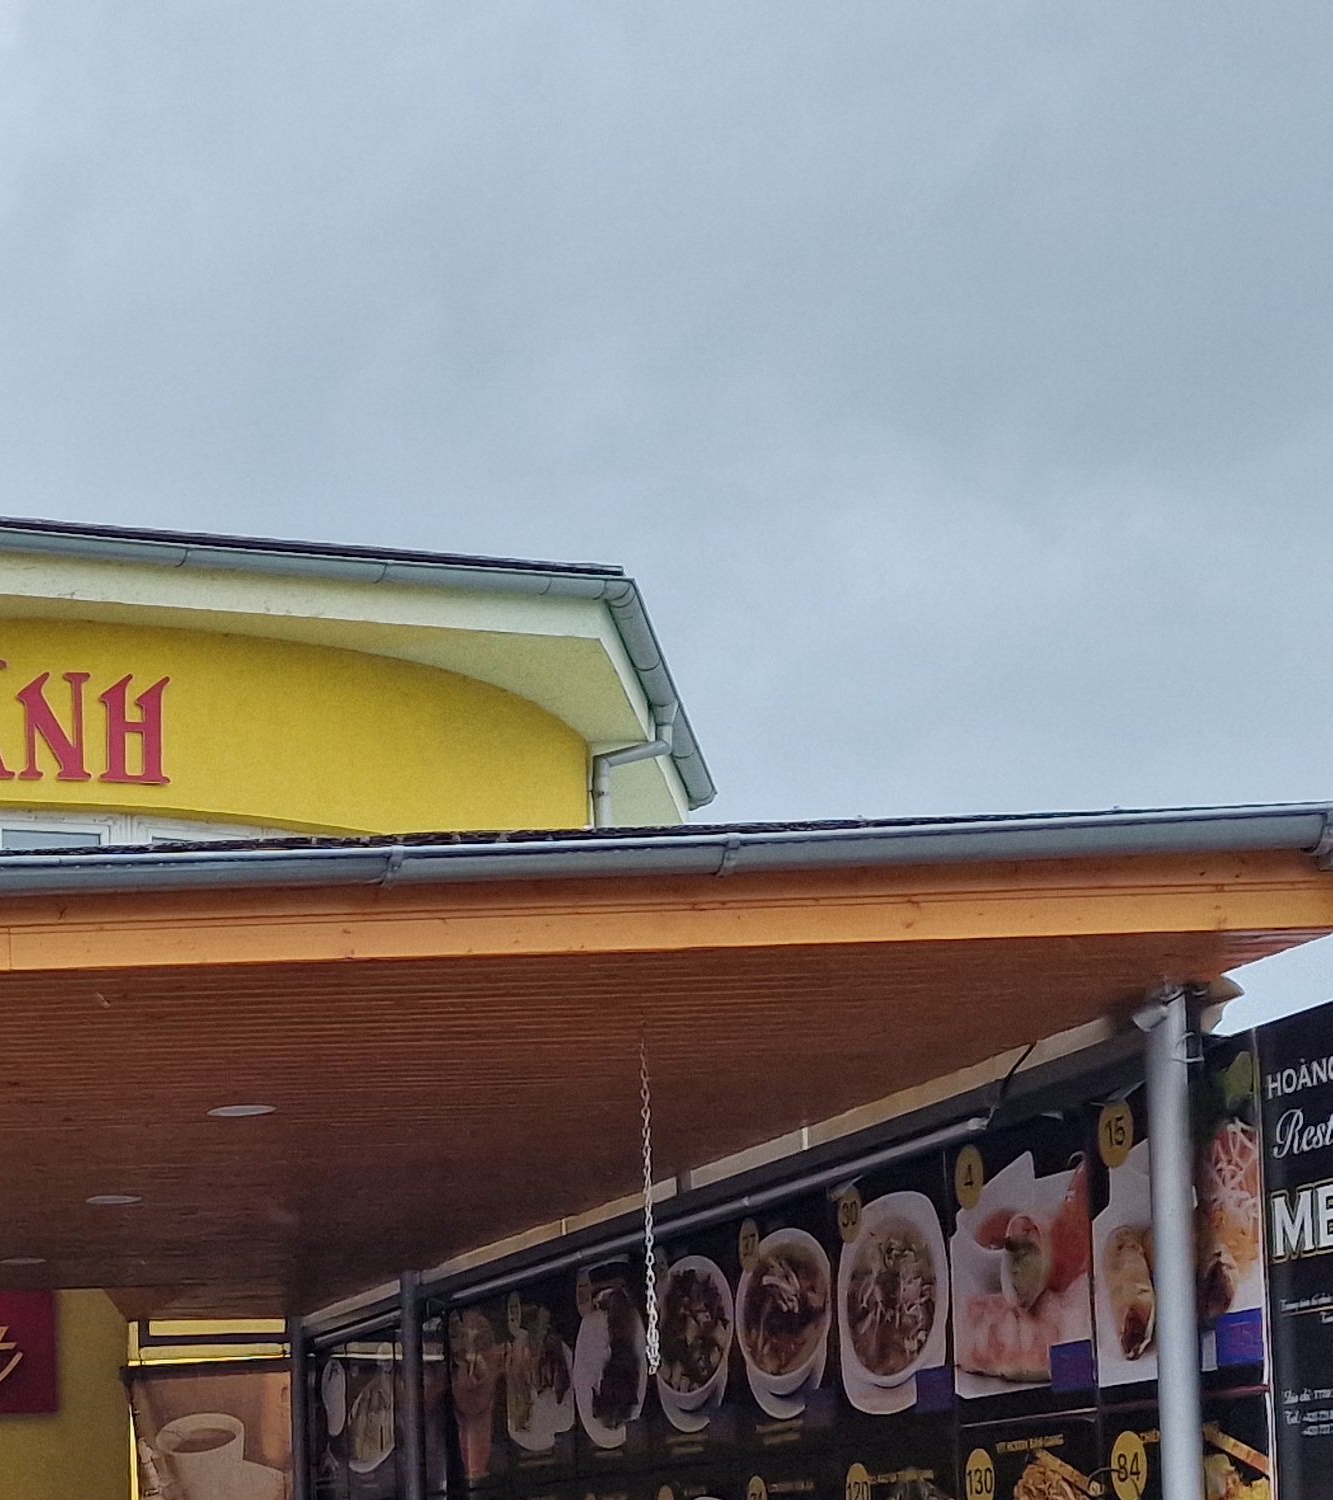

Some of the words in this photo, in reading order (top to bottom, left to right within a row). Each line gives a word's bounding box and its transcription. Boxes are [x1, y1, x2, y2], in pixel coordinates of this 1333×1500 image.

[1105, 1117, 1126, 1147] 15
[968, 1467, 993, 1495] 130
[1117, 1451, 1141, 1482] 84
